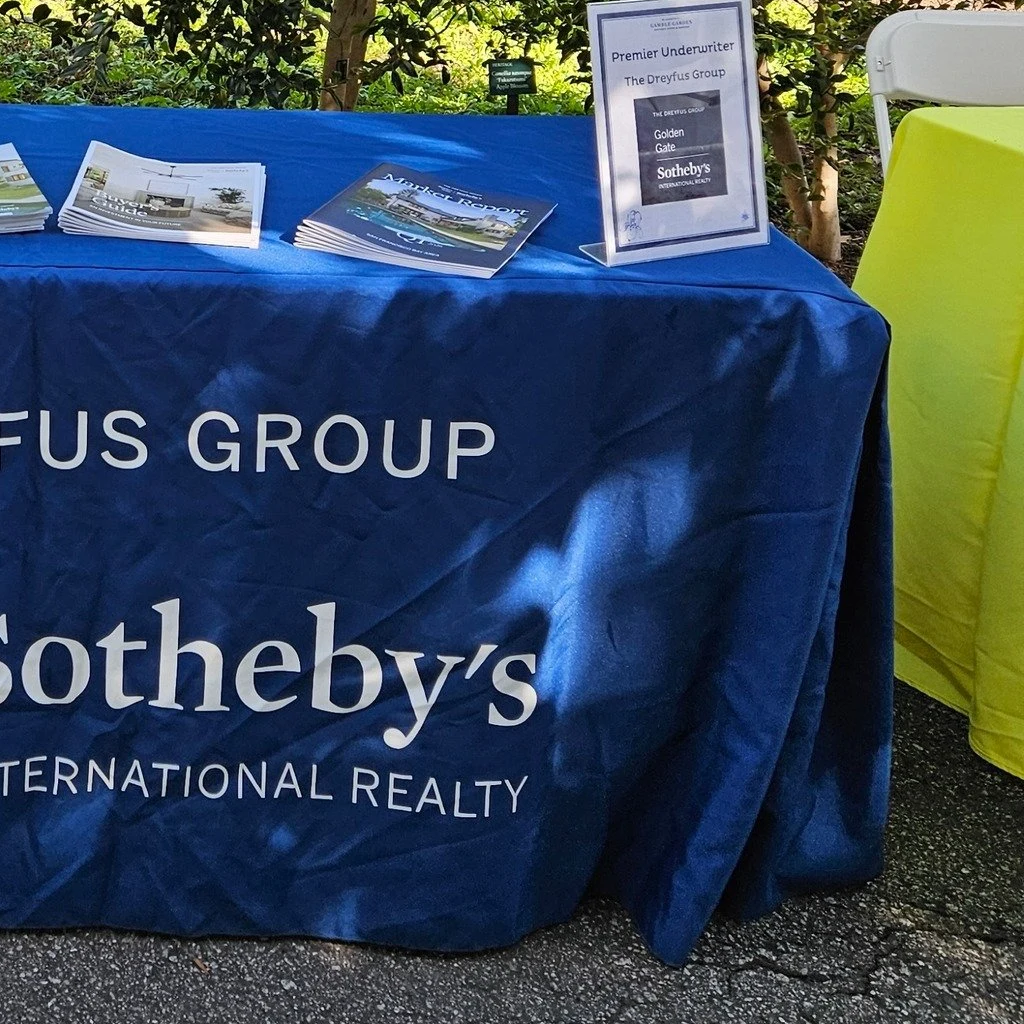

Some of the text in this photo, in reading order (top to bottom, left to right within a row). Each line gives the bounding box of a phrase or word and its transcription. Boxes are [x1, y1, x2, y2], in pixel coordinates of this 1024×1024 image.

[611, 41, 735, 63] Premier Underwriter
[624, 67, 726, 88] The Dreyfus Group
[654, 128, 685, 140] Golden
[655, 142, 676, 154] Gate
[657, 161, 711, 180] Sotheby's
[95, 189, 160, 212] Buyer's
[382, 173, 457, 202] Market
[457, 198, 530, 216] Report
[91, 196, 148, 217] Guide
[187, 410, 495, 480] GROUP
[351, 766, 529, 818] REALTY
